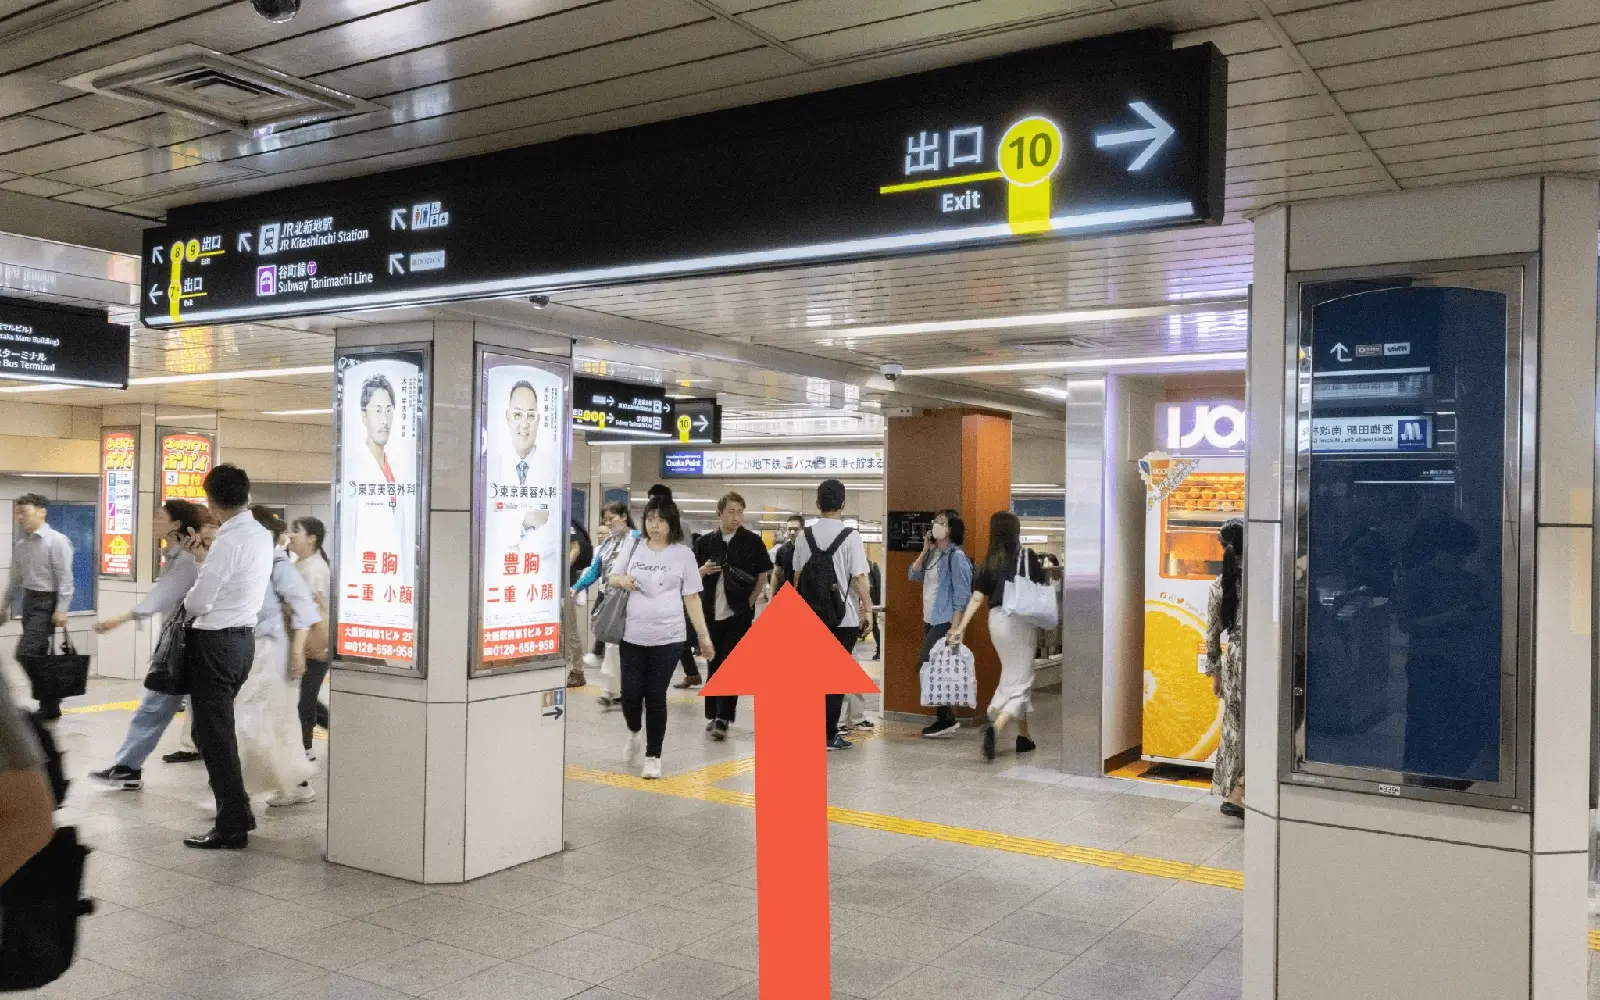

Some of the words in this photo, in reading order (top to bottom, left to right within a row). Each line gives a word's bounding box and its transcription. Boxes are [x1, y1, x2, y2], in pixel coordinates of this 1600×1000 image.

[904, 125, 983, 175] 出口
[1008, 133, 1053, 170] 10
[941, 190, 981, 213] Exit
[202, 236, 221, 251] 出口
[280, 240, 290, 250] JR
[291, 232, 336, 248] Kitashinchi
[337, 228, 368, 243] Station
[278, 261, 306, 279] 谷町線
[184, 277, 202, 292] 出口
[278, 280, 308, 292] Subway
[309, 273, 352, 289] Tanimachi
[354, 271, 374, 284] Line
[3, 360, 18, 368] Bus
[20, 361, 56, 372] Terminal
[680, 420, 688, 428] 10
[1167, 405, 1246, 448] IJO
[358, 483, 416, 496] 東京美容外科
[500, 485, 556, 498] 東京美容外科
[362, 551, 398, 575] 豊胸
[502, 552, 540, 576] 豊胸
[346, 583, 374, 602] 二重
[384, 584, 413, 604] 小顔
[486, 585, 516, 604] 二重
[526, 584, 554, 602] 小顔
[544, 626, 555, 636] 2F
